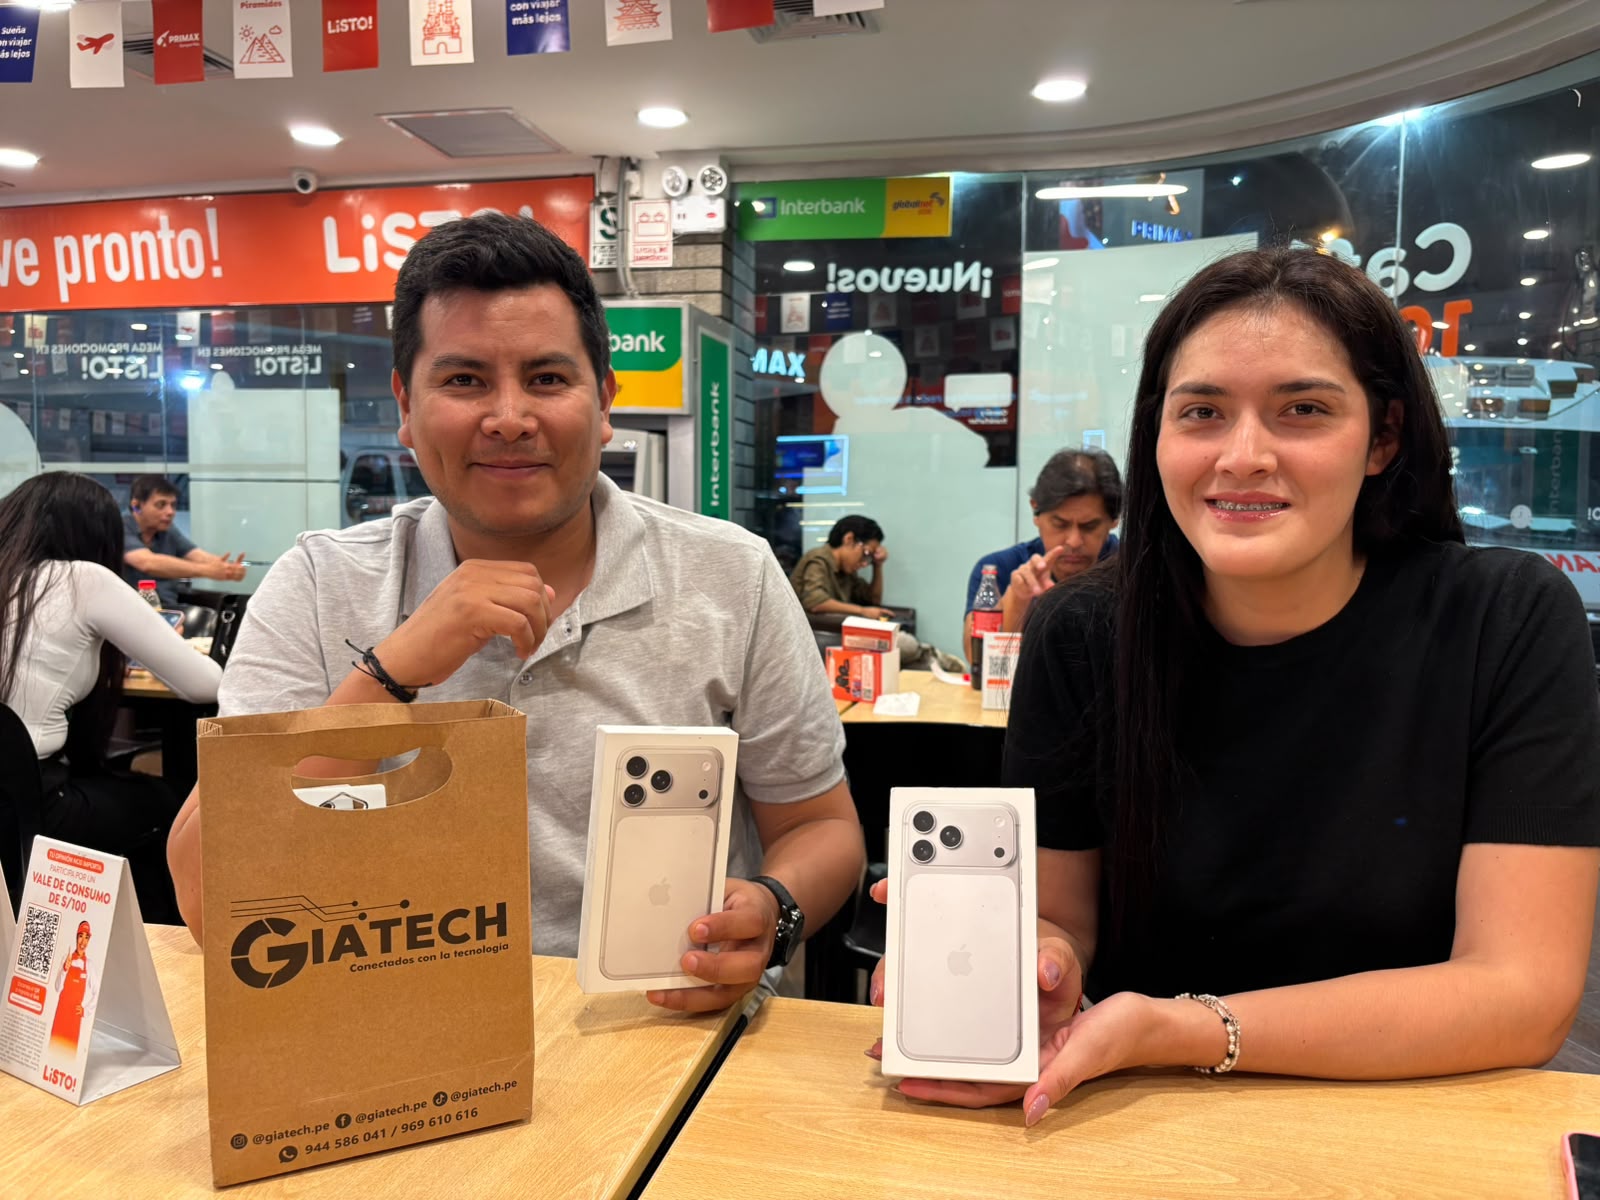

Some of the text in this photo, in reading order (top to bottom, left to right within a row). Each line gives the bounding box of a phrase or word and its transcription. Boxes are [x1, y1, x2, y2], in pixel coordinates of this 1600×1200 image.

[327, 15, 374, 34] LiSTO!
[512, 10, 562, 25] más lejos
[1, 25, 27, 35] Sueña
[168, 33, 200, 44] PRIMAX
[8, 36, 33, 48] viajar
[0, 48, 31, 60] ás lejos
[780, 197, 866, 216] Interbank
[323, 204, 534, 274] LiS
[53, 207, 223, 304] pronto!
[710, 380, 720, 507] Interbank
[33, 871, 111, 905] VALE DE CONSUMO
[48, 891, 87, 913] DE S/100
[230, 902, 508, 989] GIATECH
[349, 956, 415, 973] Conectados
[417, 954, 437, 963] con
[440, 951, 450, 960] la
[43, 1063, 77, 1093] LiSTO!
[252, 1079, 518, 1145] @giatech.pe @giatech.pe @giatech.pe
[305, 1107, 479, 1155] 944 586 041 / 969 610 616
